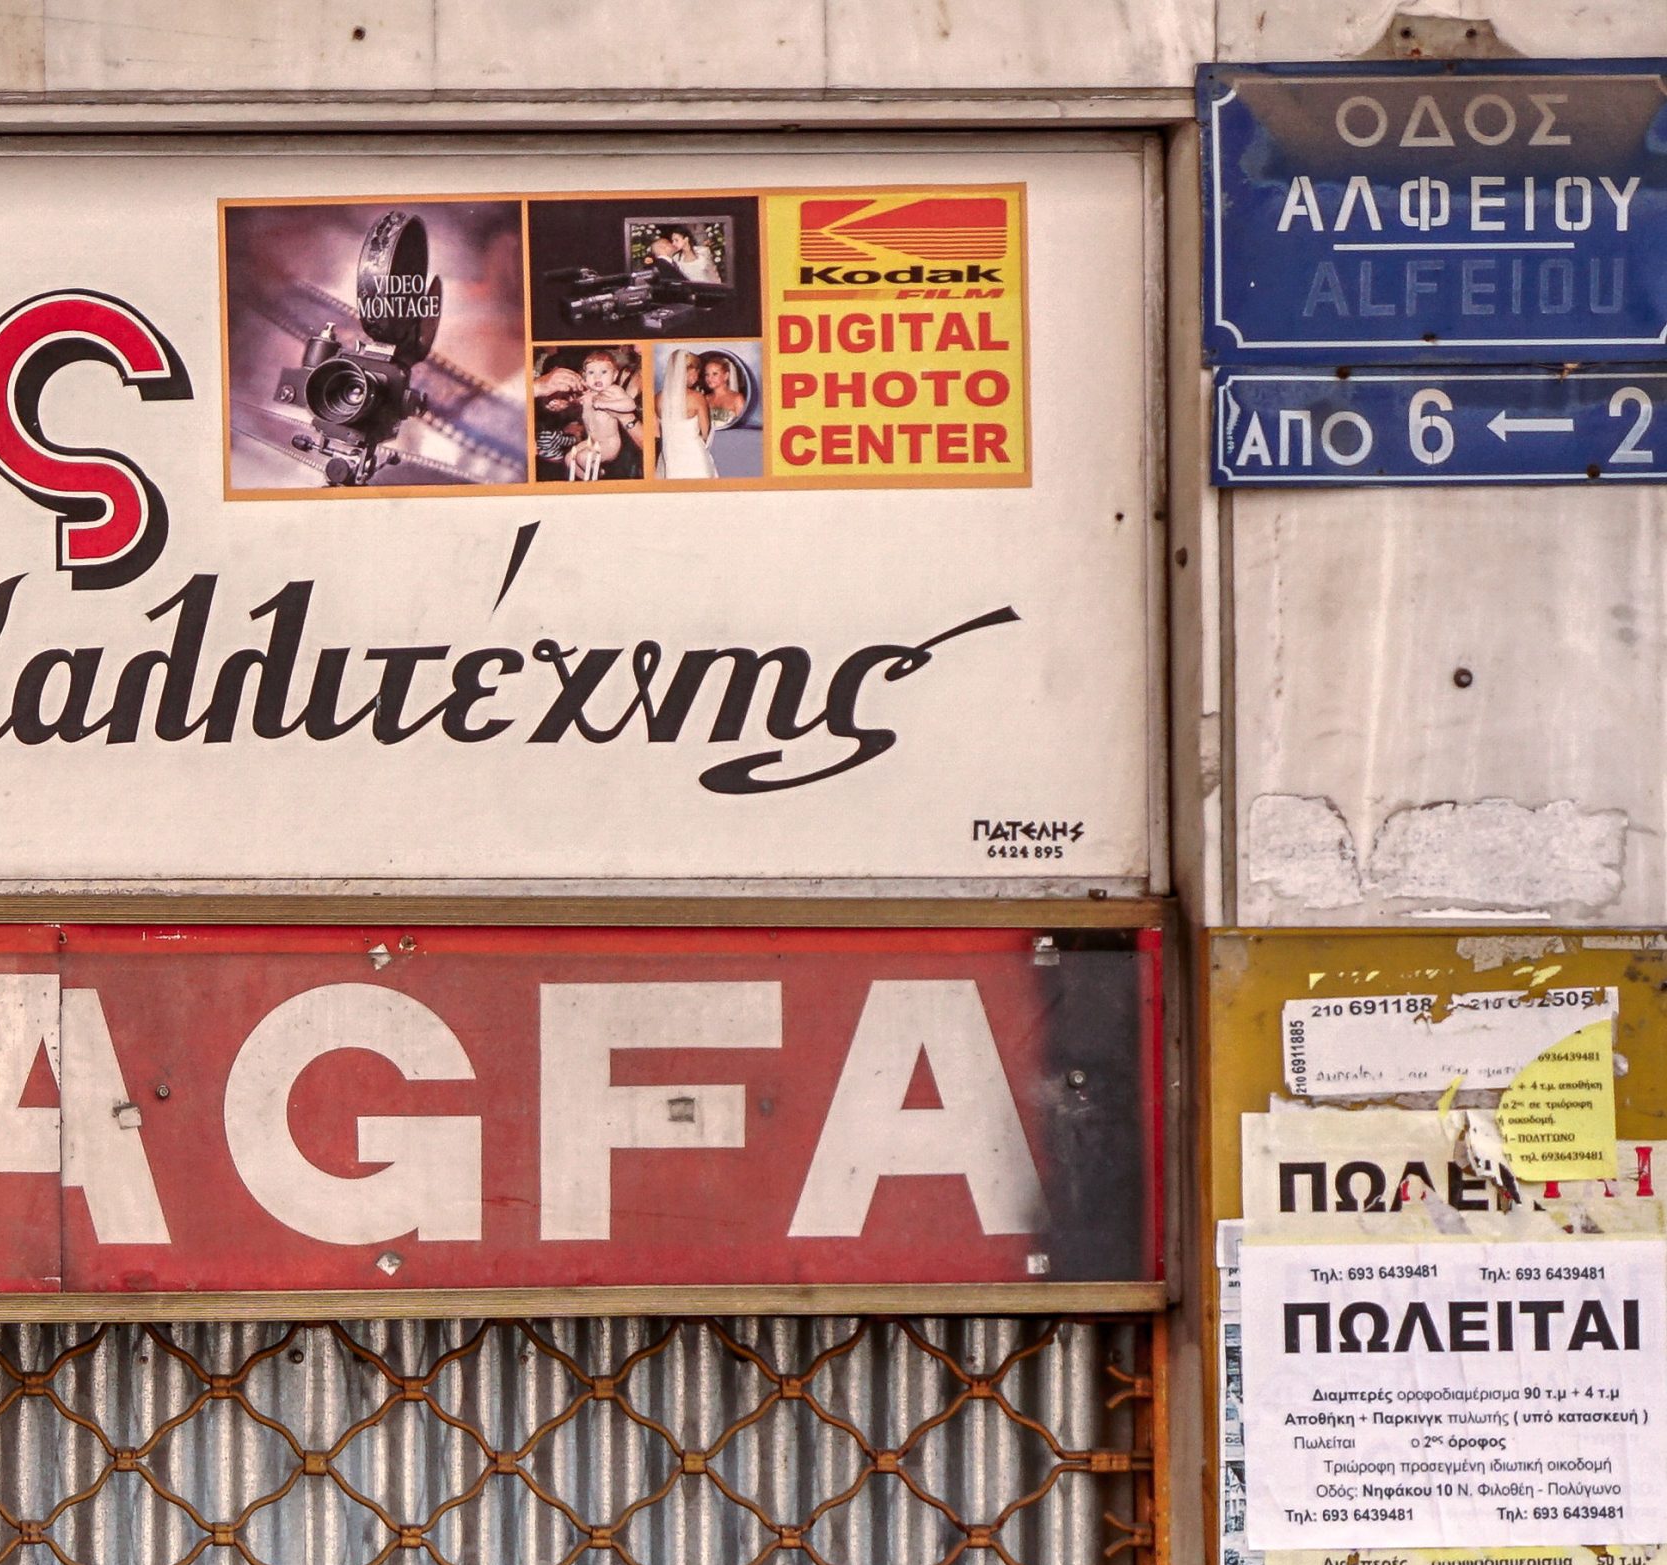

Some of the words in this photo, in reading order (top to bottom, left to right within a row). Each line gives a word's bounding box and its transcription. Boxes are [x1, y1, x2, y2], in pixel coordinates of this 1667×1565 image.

[1335, 94, 1573, 148] ΟΔΟΣ
[1276, 175, 1641, 233] ΑΛΦΕΙΟΥ
[372, 274, 424, 295] VIDEO
[799, 263, 1003, 286] Kodak
[894, 288, 1004, 300] FILM
[1301, 257, 1625, 317] ALFEIOU
[357, 295, 439, 319] MONTAGE
[778, 311, 1009, 354] DIGITAL
[780, 370, 1011, 409] PHOTO
[1235, 409, 1374, 467] ΑΠΟ
[1408, 388, 1455, 466] 6
[1608, 386, 1654, 464] 2
[779, 423, 1011, 465] CENTER
[987, 845, 1029, 858] 6424
[1034, 845, 1063, 859] 895
[1312, 1005, 1343, 1017] 210
[1349, 997, 1432, 1016] 691188
[1289, 1020, 1306, 1075] 6911885
[1310, 1268, 1344, 1284] Τηλ:
[1348, 1267, 1374, 1280] 693
[1379, 1264, 1438, 1279] 6439481
[1479, 1267, 1511, 1283] Τηλ:
[1516, 1267, 1541, 1280] 693
[1546, 1266, 1605, 1280] 6439481
[1283, 1299, 1640, 1353] ΠΩΛΕΙΤΑΙ
[1311, 1387, 1393, 1403] Διαμπερές
[1397, 1386, 1520, 1403] οροφοδιαμέρισμα
[1524, 1386, 1541, 1399] 90
[1585, 1386, 1594, 1399] 4
[1284, 1412, 1355, 1428] Αποθήκη
[1372, 1412, 1443, 1427] Παρκινγκ
[1448, 1410, 1509, 1426] πυλωτής
[1293, 1436, 1355, 1450] Πωλείται
[1448, 1434, 1507, 1450] όροφος
[1324, 1459, 1396, 1475] Τριώροφη
[1401, 1459, 1485, 1475] προσεγμένη
[1490, 1458, 1543, 1474] ιδιωτική
[1547, 1457, 1612, 1474] οικοδομή
[1316, 1484, 1358, 1500] Οδός:
[1362, 1483, 1432, 1499] Νηφάκου
[1436, 1484, 1453, 1496] 10
[1477, 1482, 1534, 1498] Φιλοθέη
[1548, 1482, 1621, 1498] Πολύγωνο
[1285, 1509, 1317, 1525] Τηλ:
[1322, 1509, 1348, 1521] 693
[1353, 1508, 1413, 1521] 6439481
[1496, 1507, 1528, 1522] Τηλ:
[1533, 1506, 1559, 1519] 693
[1563, 1506, 1624, 1519] 6439481
